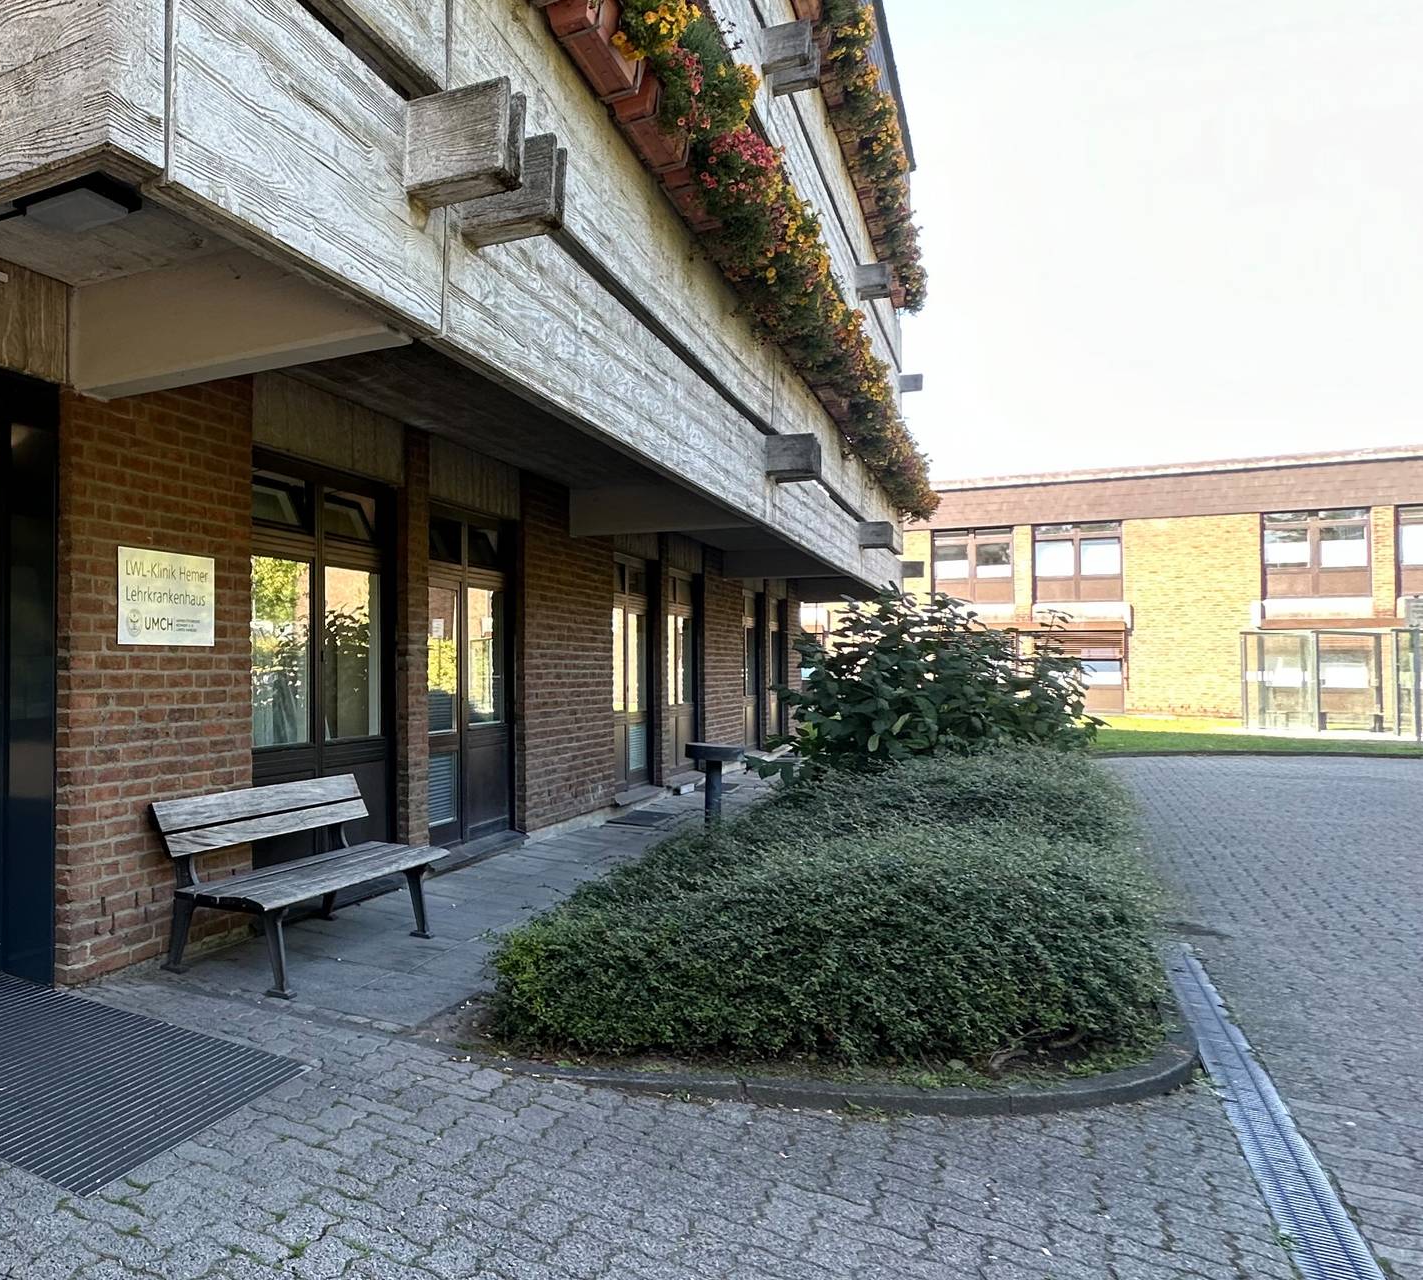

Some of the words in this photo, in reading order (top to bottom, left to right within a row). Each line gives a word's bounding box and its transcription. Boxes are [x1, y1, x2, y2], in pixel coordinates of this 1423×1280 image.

[125, 560, 176, 580] LWL-Klinik
[179, 567, 208, 582] Hemer
[125, 586, 206, 607] Lehrkrankenhaus
[144, 617, 173, 631] UMCH
